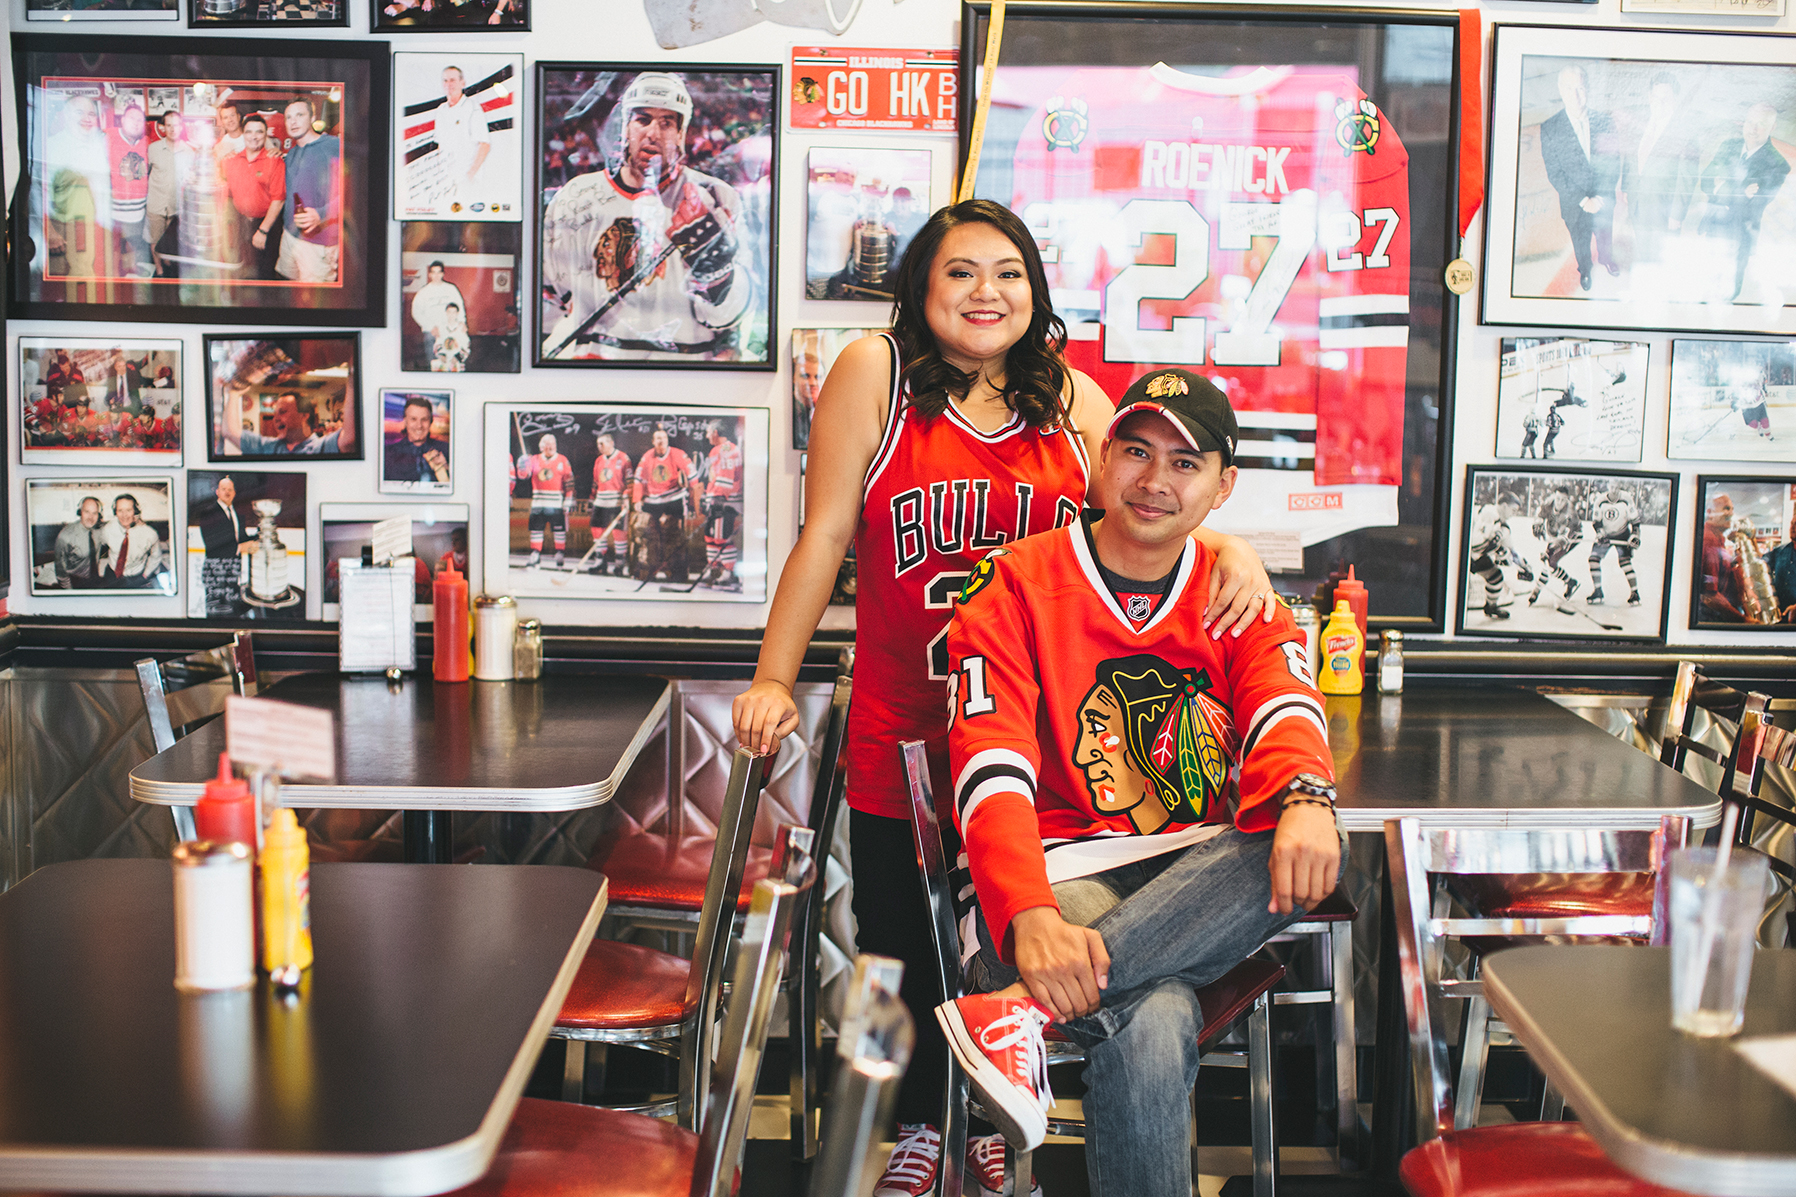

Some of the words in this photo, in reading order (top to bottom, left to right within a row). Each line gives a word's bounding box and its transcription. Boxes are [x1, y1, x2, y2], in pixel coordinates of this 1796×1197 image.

[849, 57, 904, 69] ILLINOIS
[827, 71, 869, 116] GO
[890, 72, 931, 116] HK
[1141, 140, 1291, 194] ROENICK
[1325, 207, 1401, 273] 27
[1103, 198, 1317, 367] 27
[1289, 492, 1343, 511] CCM
[890, 479, 1078, 579] BULL
